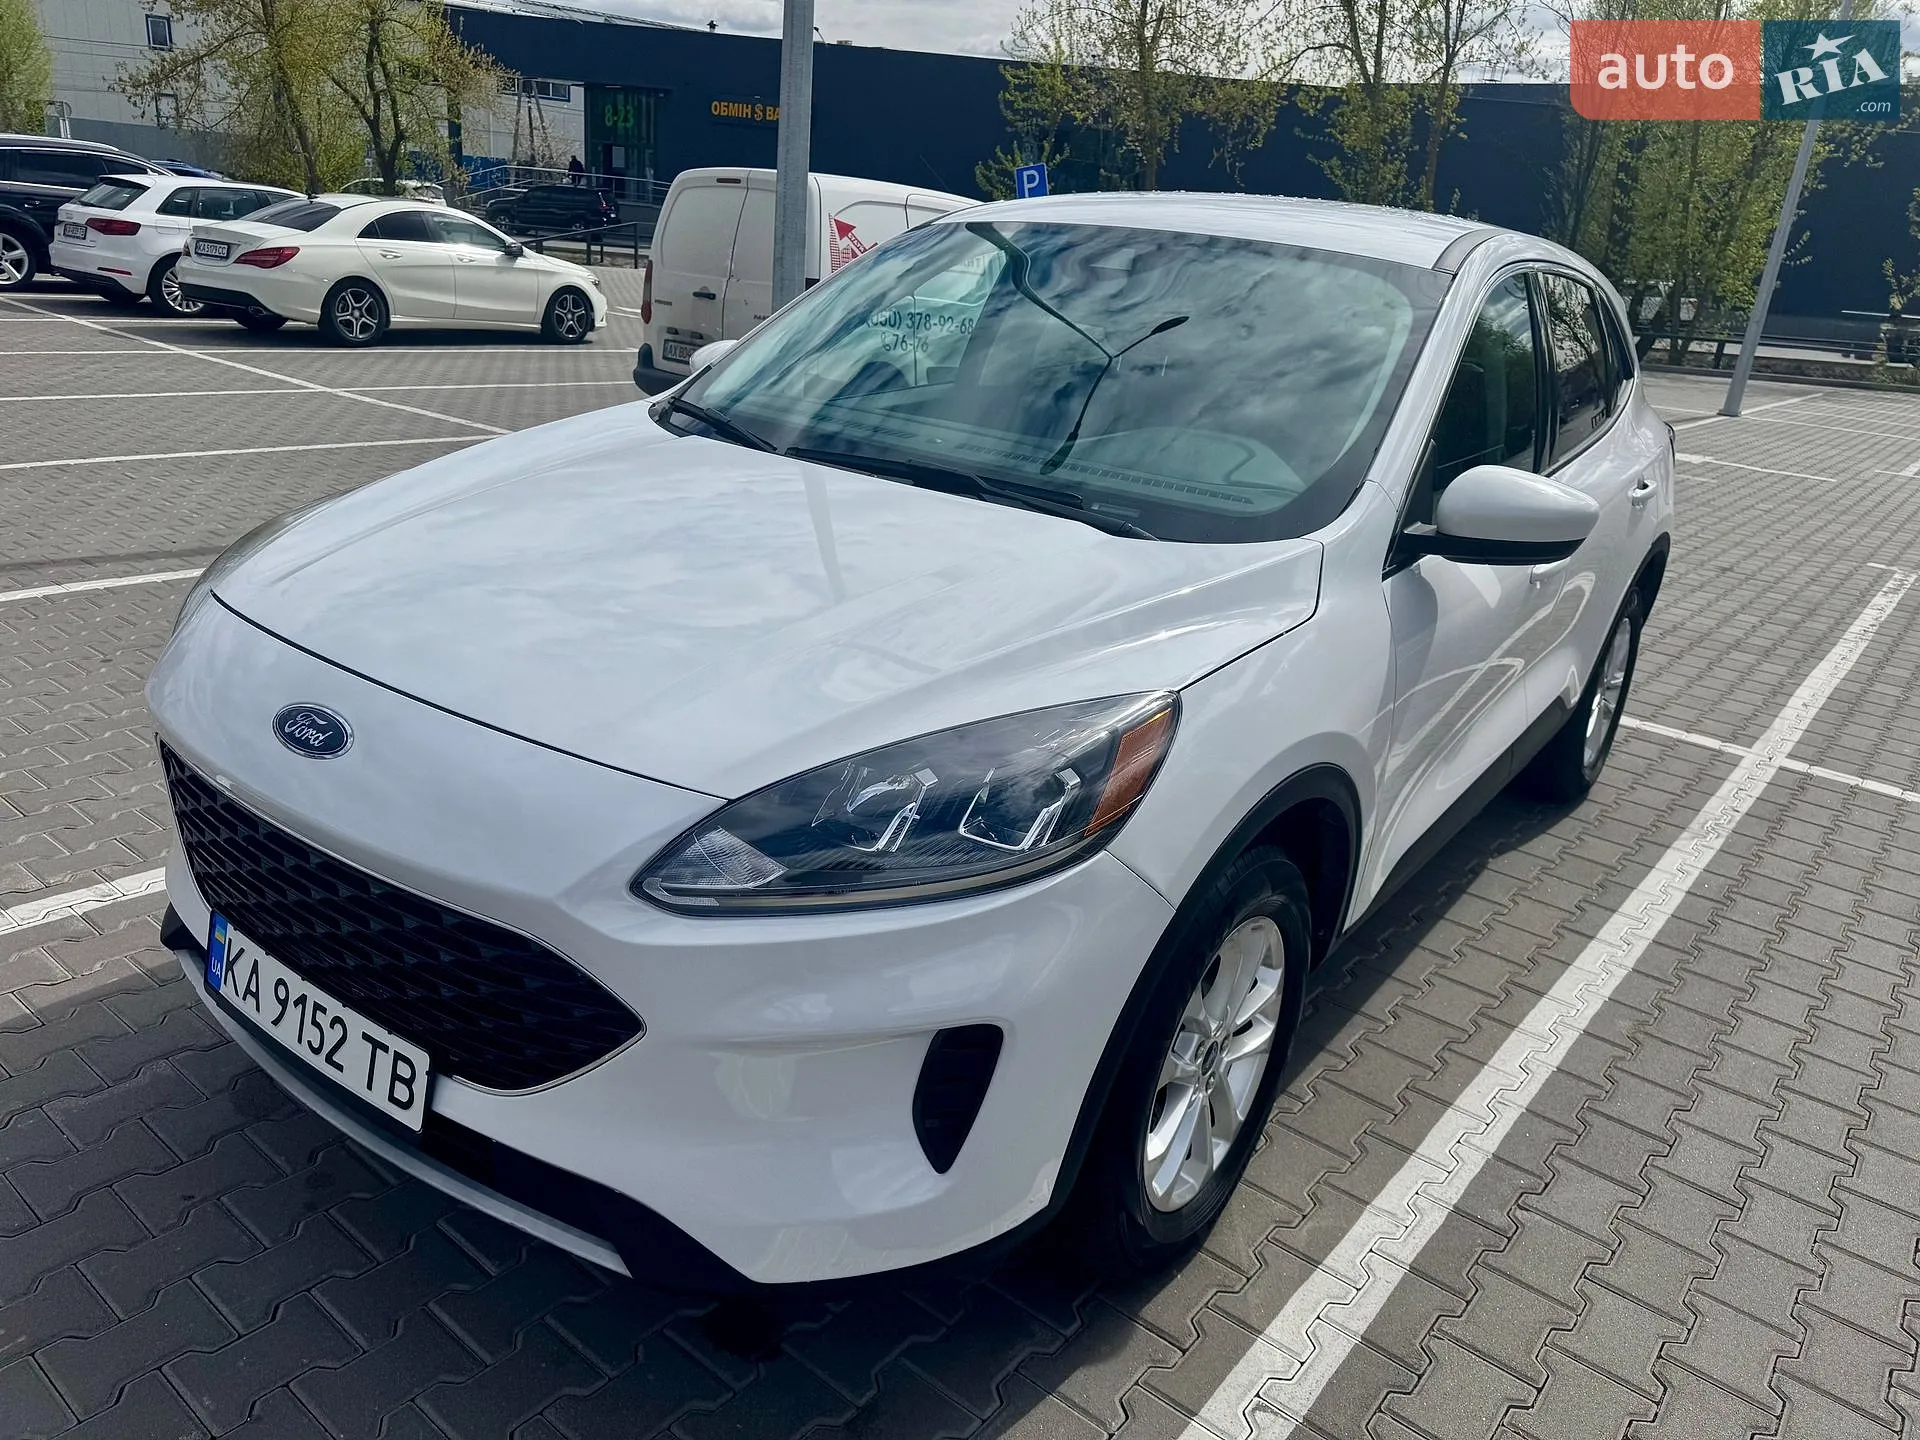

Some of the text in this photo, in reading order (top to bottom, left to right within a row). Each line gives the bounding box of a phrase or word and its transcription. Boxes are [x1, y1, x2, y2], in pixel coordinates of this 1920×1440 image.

[604, 104, 635, 128] 8-23
[711, 100, 751, 119] ОБМІН
[1023, 169, 1040, 198] P
[906, 311, 975, 334] 378-92-68
[284, 711, 334, 747] Ford
[211, 957, 222, 978] UA
[223, 937, 417, 1111] KA 9152 TB
